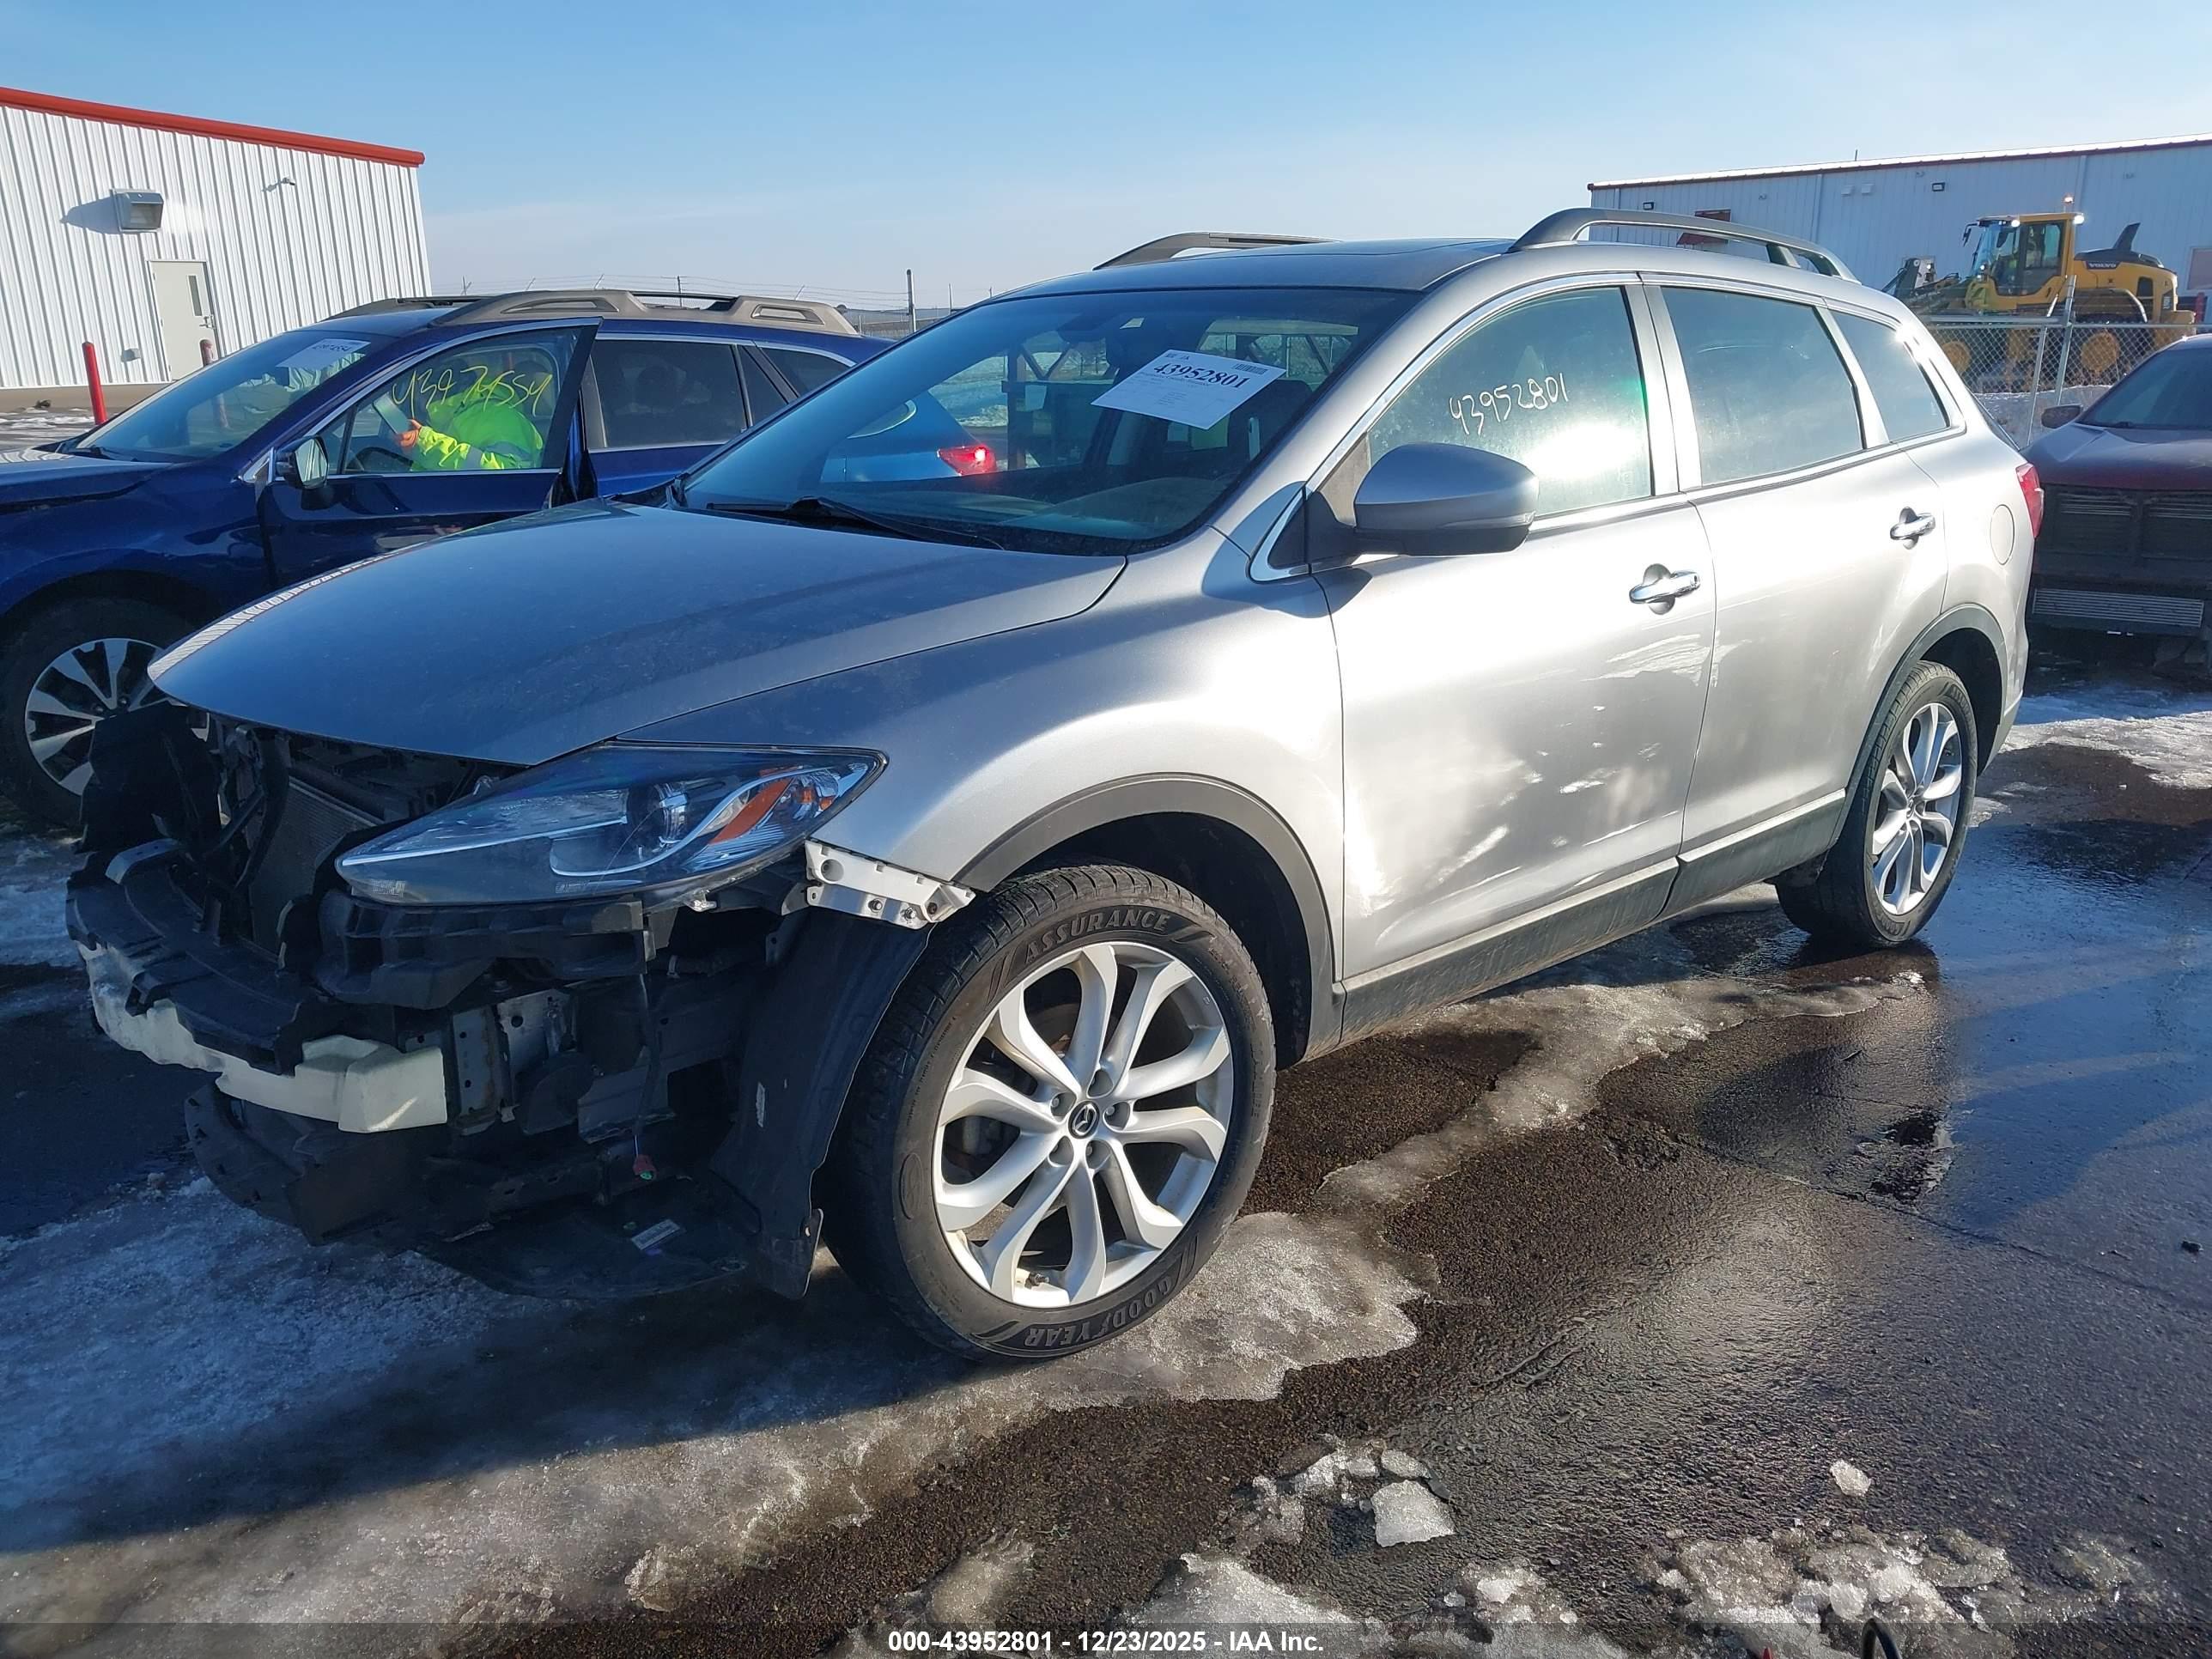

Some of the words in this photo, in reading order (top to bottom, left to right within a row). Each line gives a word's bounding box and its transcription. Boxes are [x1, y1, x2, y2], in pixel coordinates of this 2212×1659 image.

[1153, 362, 1251, 389] 43952801
[1449, 372, 1571, 436] 43952801
[1025, 908, 1171, 964] ASSURANCE
